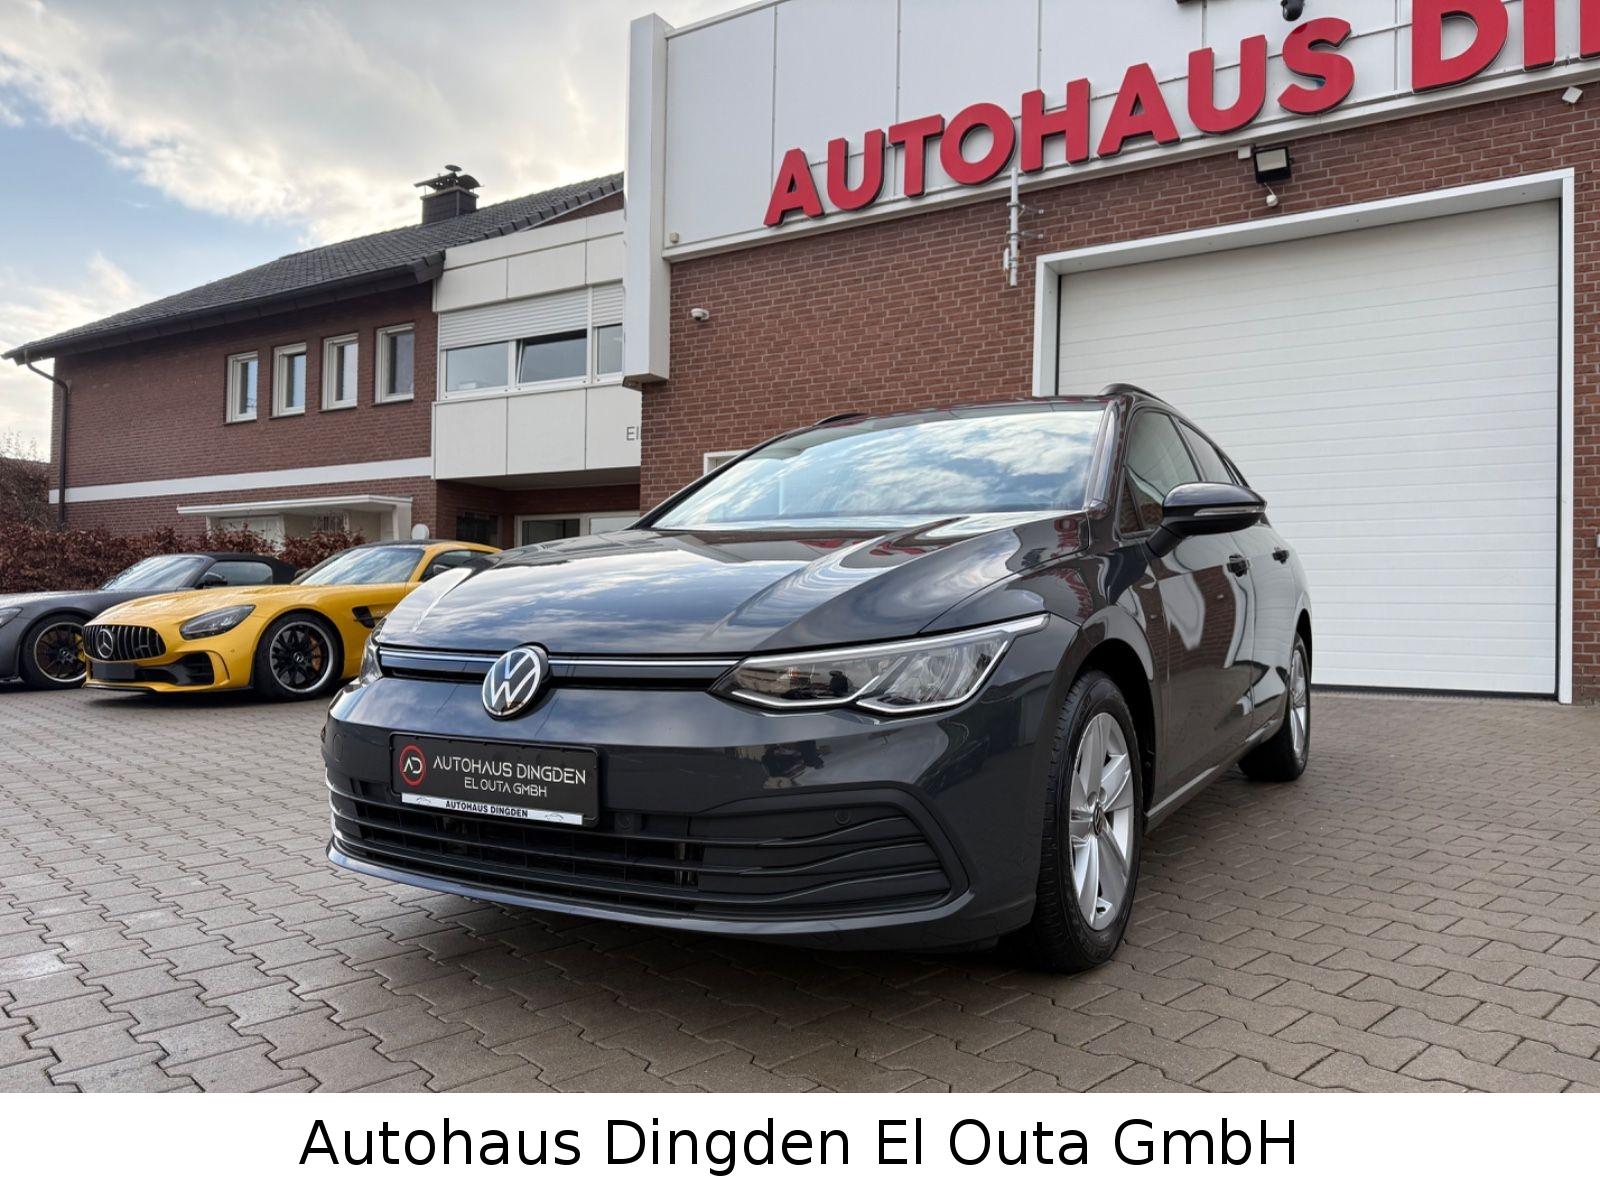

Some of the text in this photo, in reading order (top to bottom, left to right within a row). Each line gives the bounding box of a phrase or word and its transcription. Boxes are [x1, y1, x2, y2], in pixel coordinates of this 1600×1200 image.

[765, 0, 1600, 226] AUTOHAUS DI
[432, 755, 586, 785] AUTOHAUS DINGDEN
[464, 776, 548, 798] EL OUTA GMBH
[445, 800, 529, 818] AUTOHAUS DINGDEN
